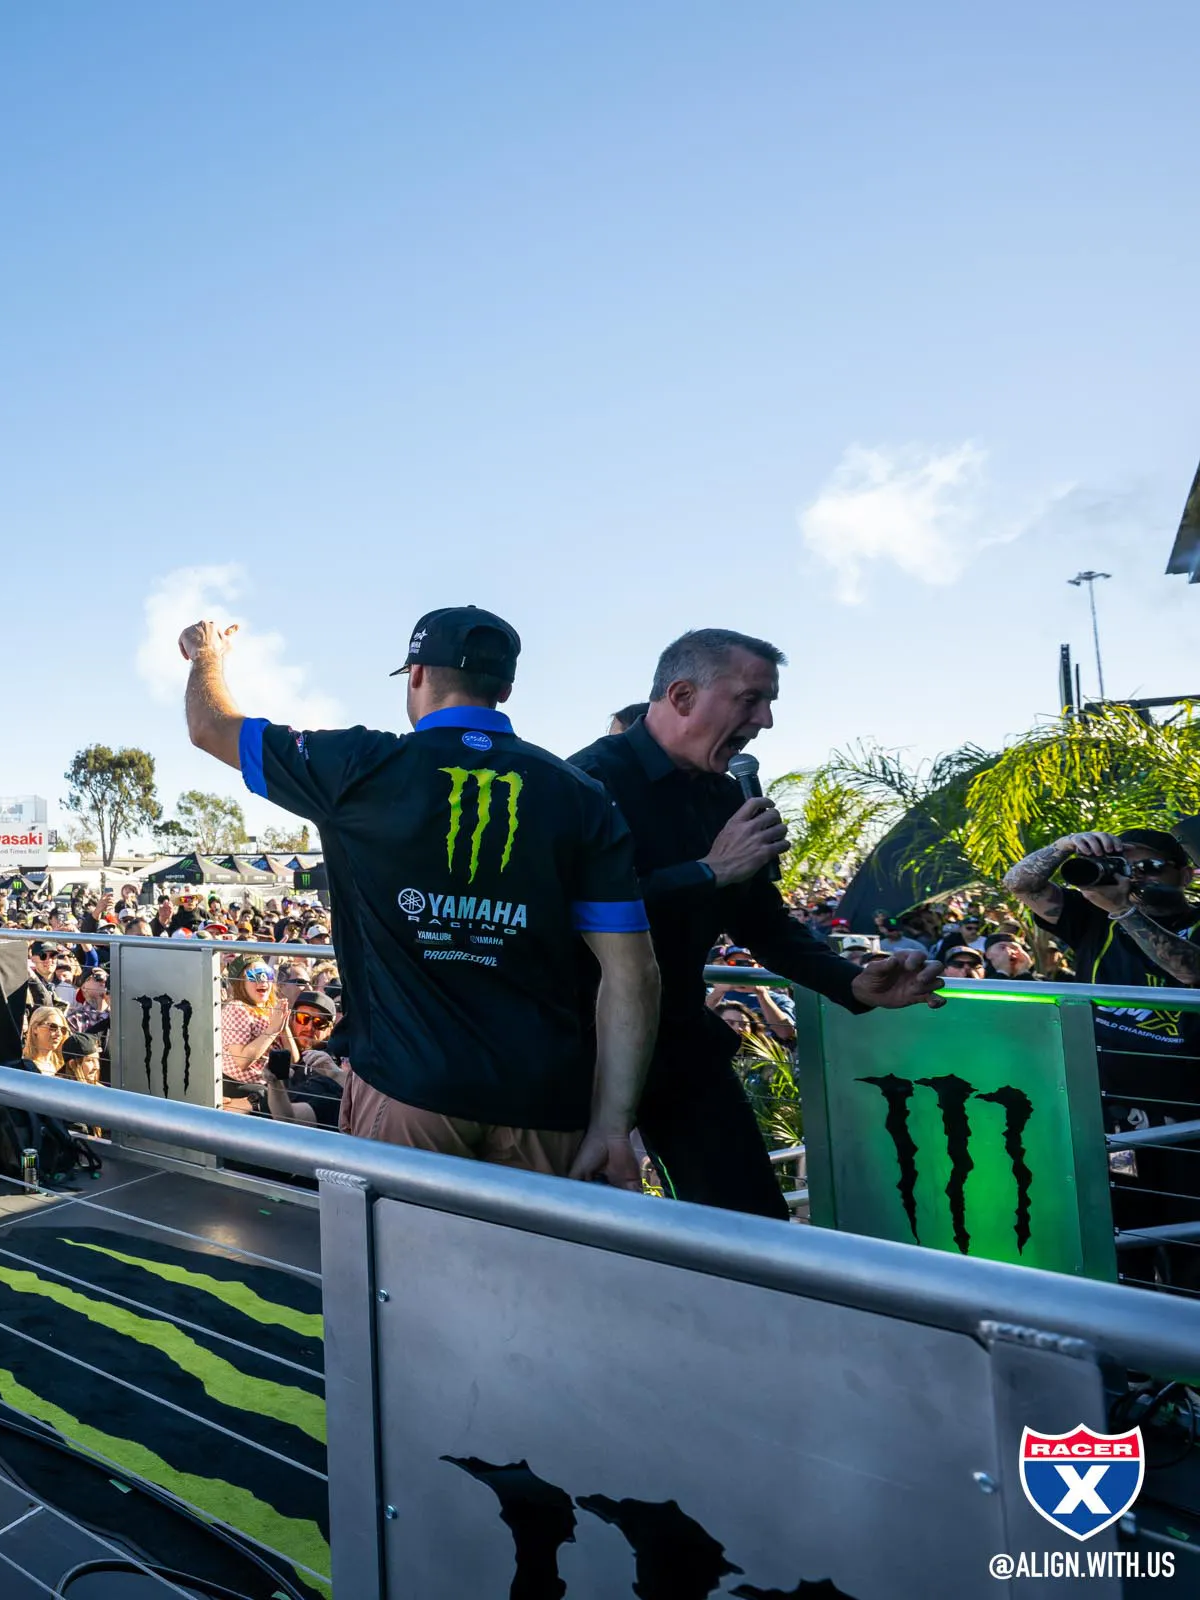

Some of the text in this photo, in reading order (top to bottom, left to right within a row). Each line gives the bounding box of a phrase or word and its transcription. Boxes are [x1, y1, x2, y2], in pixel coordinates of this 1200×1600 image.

[427, 892, 528, 929] YAMAHA
[408, 915, 517, 935] RACING
[417, 929, 504, 946] YAMALUBE YAMAHA
[423, 949, 498, 967] PROGRESSIVE
